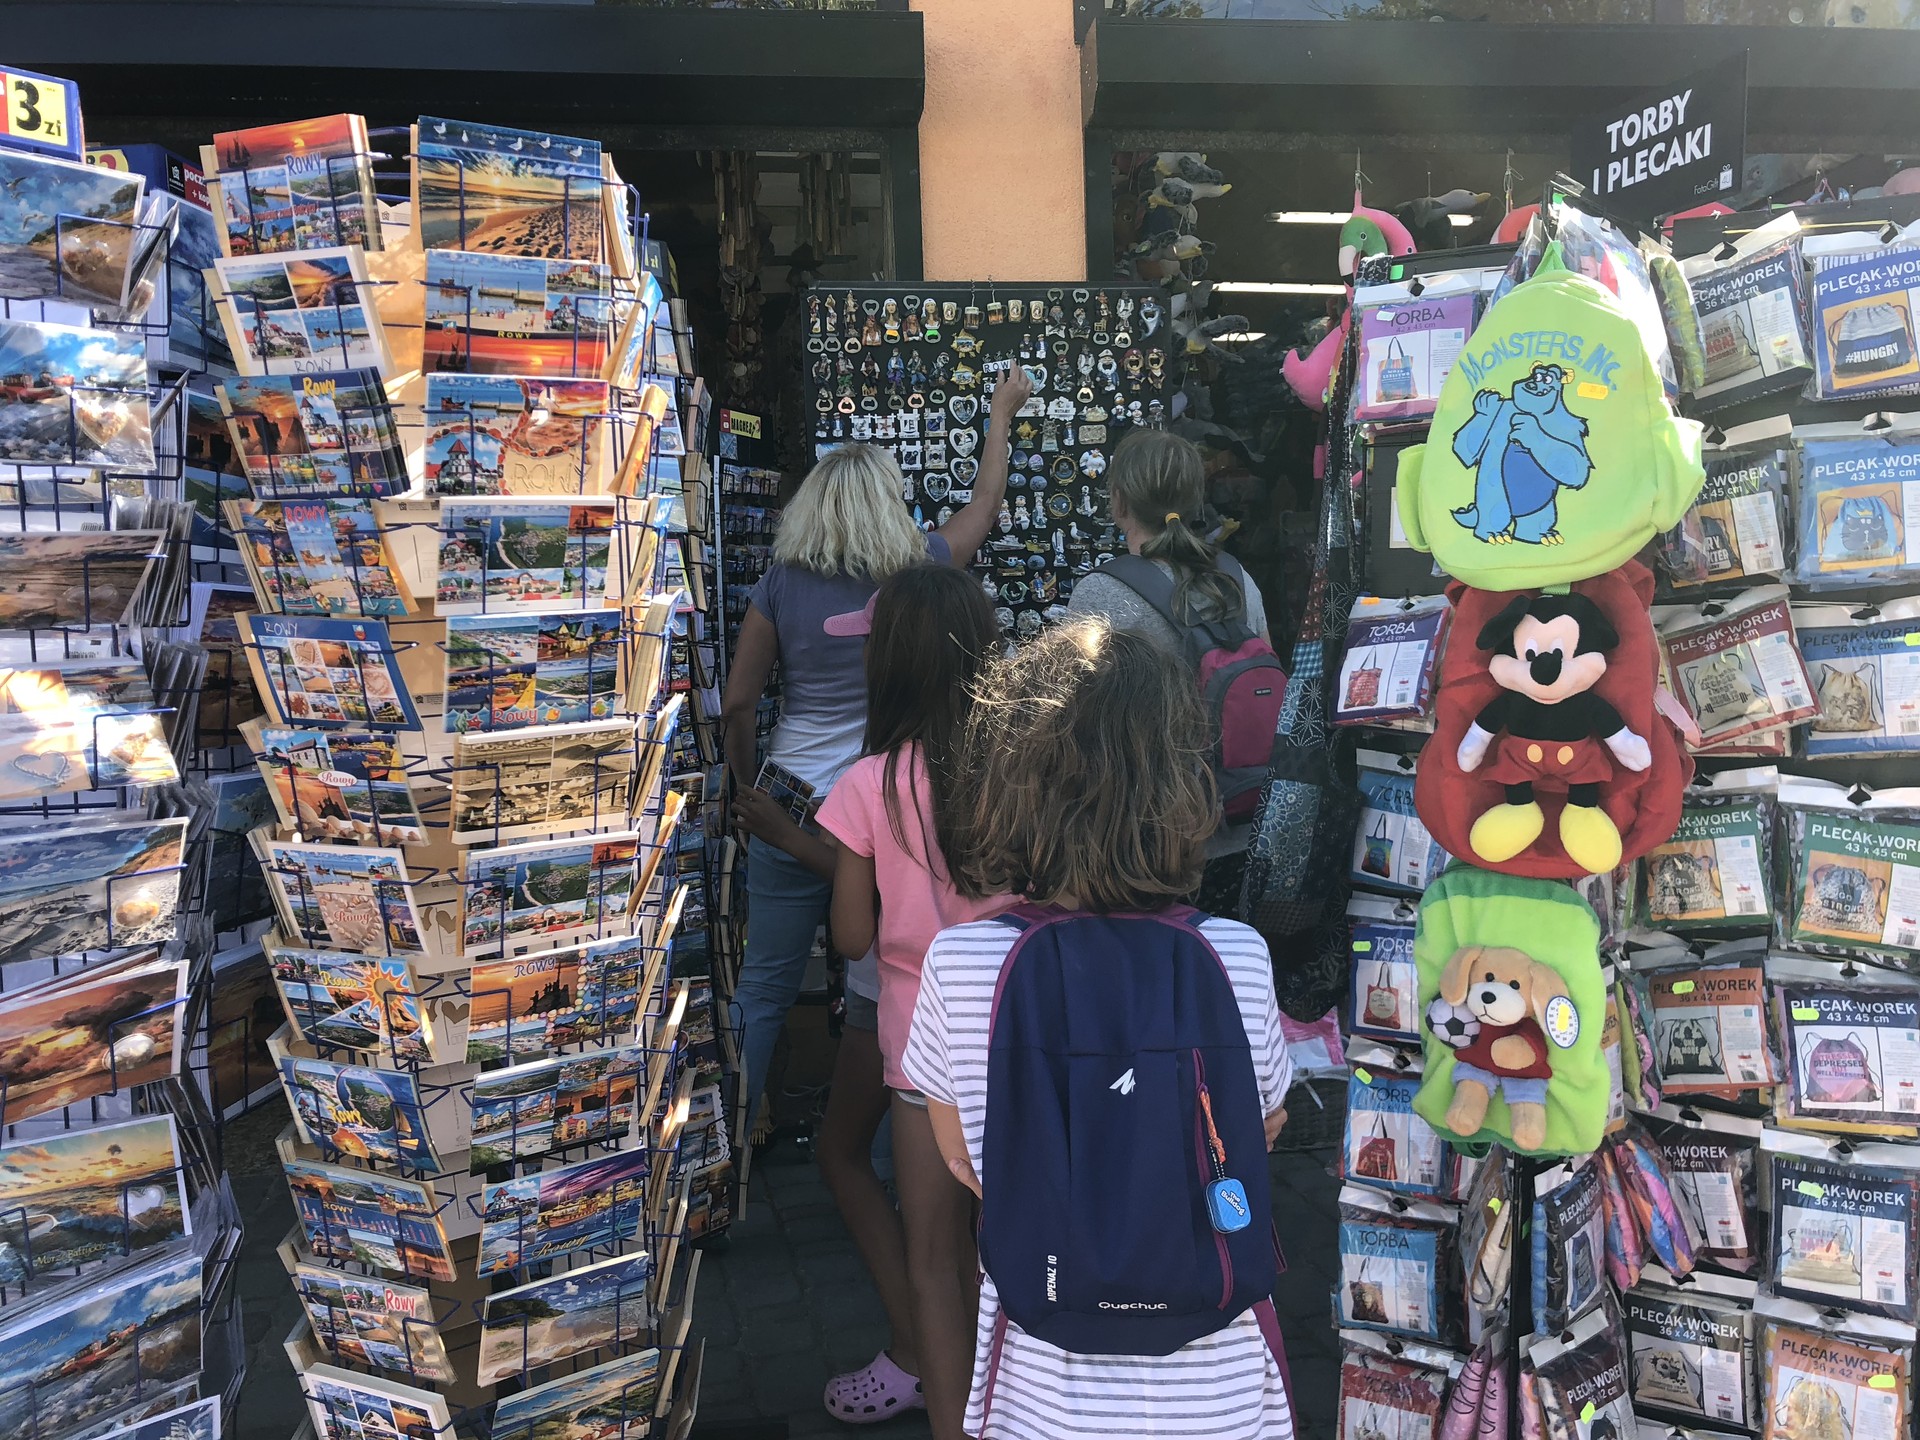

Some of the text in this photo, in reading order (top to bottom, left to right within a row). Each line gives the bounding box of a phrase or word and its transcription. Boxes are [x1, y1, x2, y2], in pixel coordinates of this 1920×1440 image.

[15, 80, 42, 132] 3
[1606, 89, 1692, 153] TORBY
[284, 151, 321, 177] ROWY
[1593, 123, 1712, 195] I PLECAKI
[1855, 275, 1920, 295] 43 x 45 cm
[1704, 284, 1760, 310] 36 x 42 cm
[1389, 306, 1446, 328] TORBA
[498, 329, 532, 340] ROWY
[1845, 342, 1899, 364] #HUNGRY
[294, 356, 332, 374] ROWY
[302, 376, 337, 399] Rowy
[1850, 468, 1916, 482] 43 x 45 cm
[1710, 487, 1725, 498] 45
[285, 505, 327, 523] ROWY
[264, 621, 298, 637] ROWY
[1369, 621, 1416, 639] TORBA
[1671, 607, 1783, 654] PLECAK-WOREK
[1703, 627, 1759, 652] 36 x 42 cm
[1834, 644, 1848, 654] 36
[1859, 642, 1873, 652] 42
[1878, 642, 1894, 650] cm
[491, 708, 538, 726] Rowy
[321, 772, 355, 786] Rowy
[1684, 829, 1691, 837] x
[1693, 826, 1708, 836] 45
[1710, 825, 1726, 835] cm
[1812, 823, 1920, 853] PLECAK-WOR
[1844, 842, 1907, 861] 43 x 45 cm
[334, 910, 370, 923] Rowy
[1375, 936, 1413, 954] TORB
[514, 956, 557, 978] ROWY
[319, 970, 358, 988] Rowy
[1653, 979, 1757, 995] PLEK-WOREK
[1701, 993, 1713, 1001] 42
[1716, 993, 1730, 1001] cm
[1790, 999, 1917, 1015] PLECAK-WOREK
[1826, 1013, 1842, 1023] 43
[1854, 1013, 1870, 1023] 45
[1873, 1015, 1890, 1024] cm
[1371, 1086, 1412, 1103] TORB
[326, 1106, 363, 1125] Rowy
[1690, 1160, 1704, 1168] cm
[1230, 1191, 1241, 1203] The
[1781, 1178, 1906, 1207] PLAK-WOREK
[322, 1201, 354, 1214] ROWY
[1221, 1190, 1246, 1216] Bulldog
[1815, 1197, 1876, 1214] 36 x 42 cm
[1358, 1230, 1410, 1250] TORBA
[1047, 1266, 1058, 1302] ARPENAZ
[384, 1288, 416, 1317] Rowy
[1098, 1301, 1168, 1310] Quechua
[1630, 1306, 1740, 1339] PLECAK-WOREK
[1659, 1326, 1714, 1344] 36 x 42 cm
[1781, 1339, 1900, 1378] PLECAK-WOREK
[1813, 1361, 1826, 1371] 36
[1839, 1369, 1853, 1379] 42
